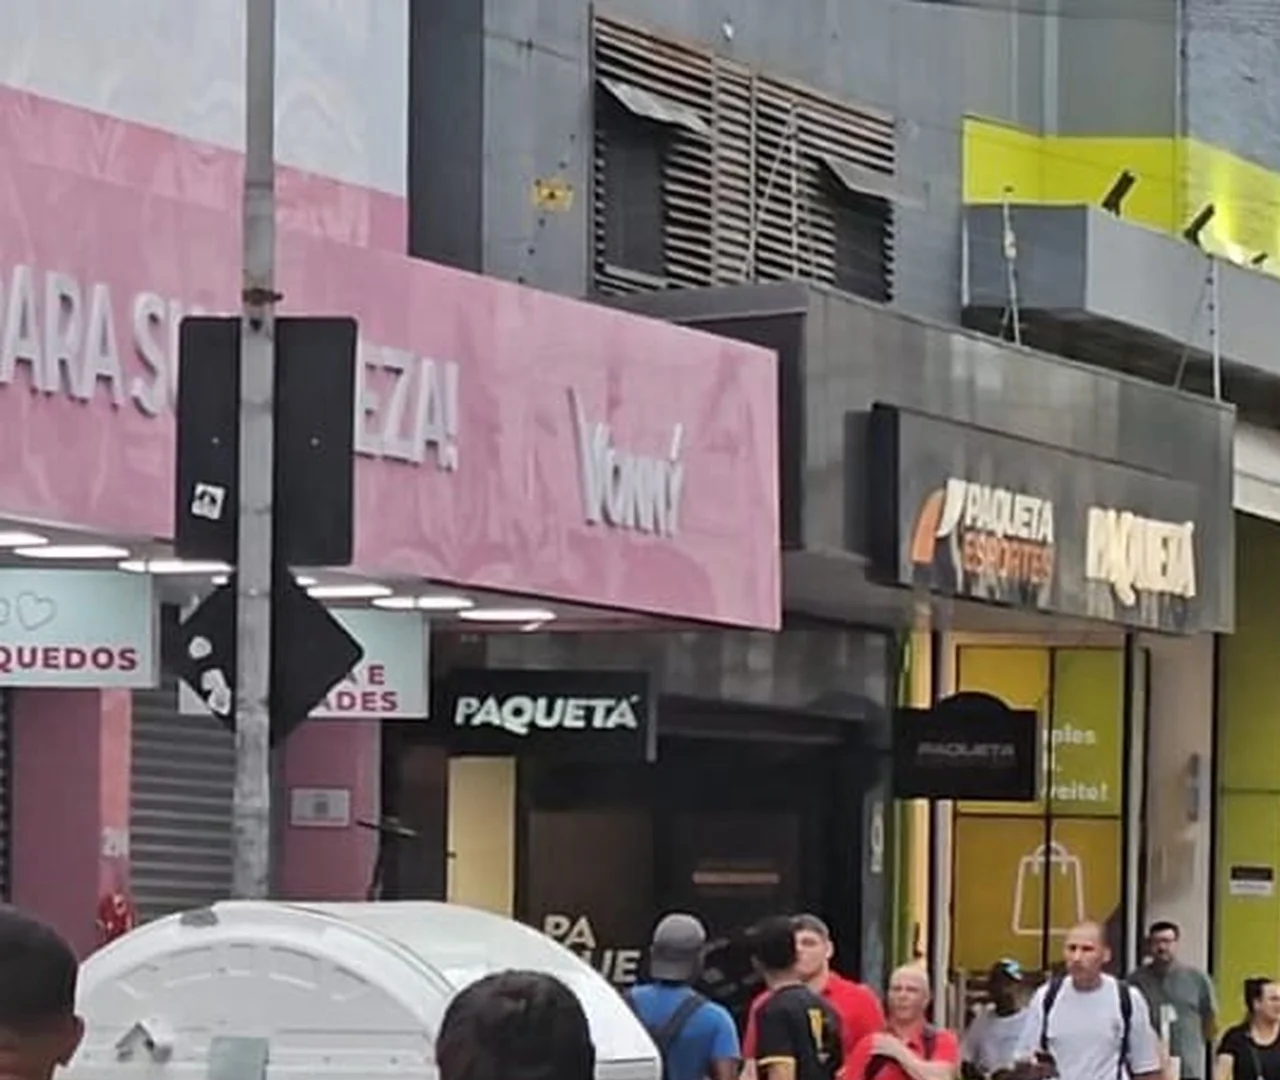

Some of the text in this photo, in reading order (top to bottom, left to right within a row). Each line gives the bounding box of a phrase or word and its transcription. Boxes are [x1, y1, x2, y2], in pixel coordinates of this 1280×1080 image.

[0, 264, 125, 411] ARA
[354, 342, 460, 473] EZA!
[1043, 723, 1097, 747] ples
